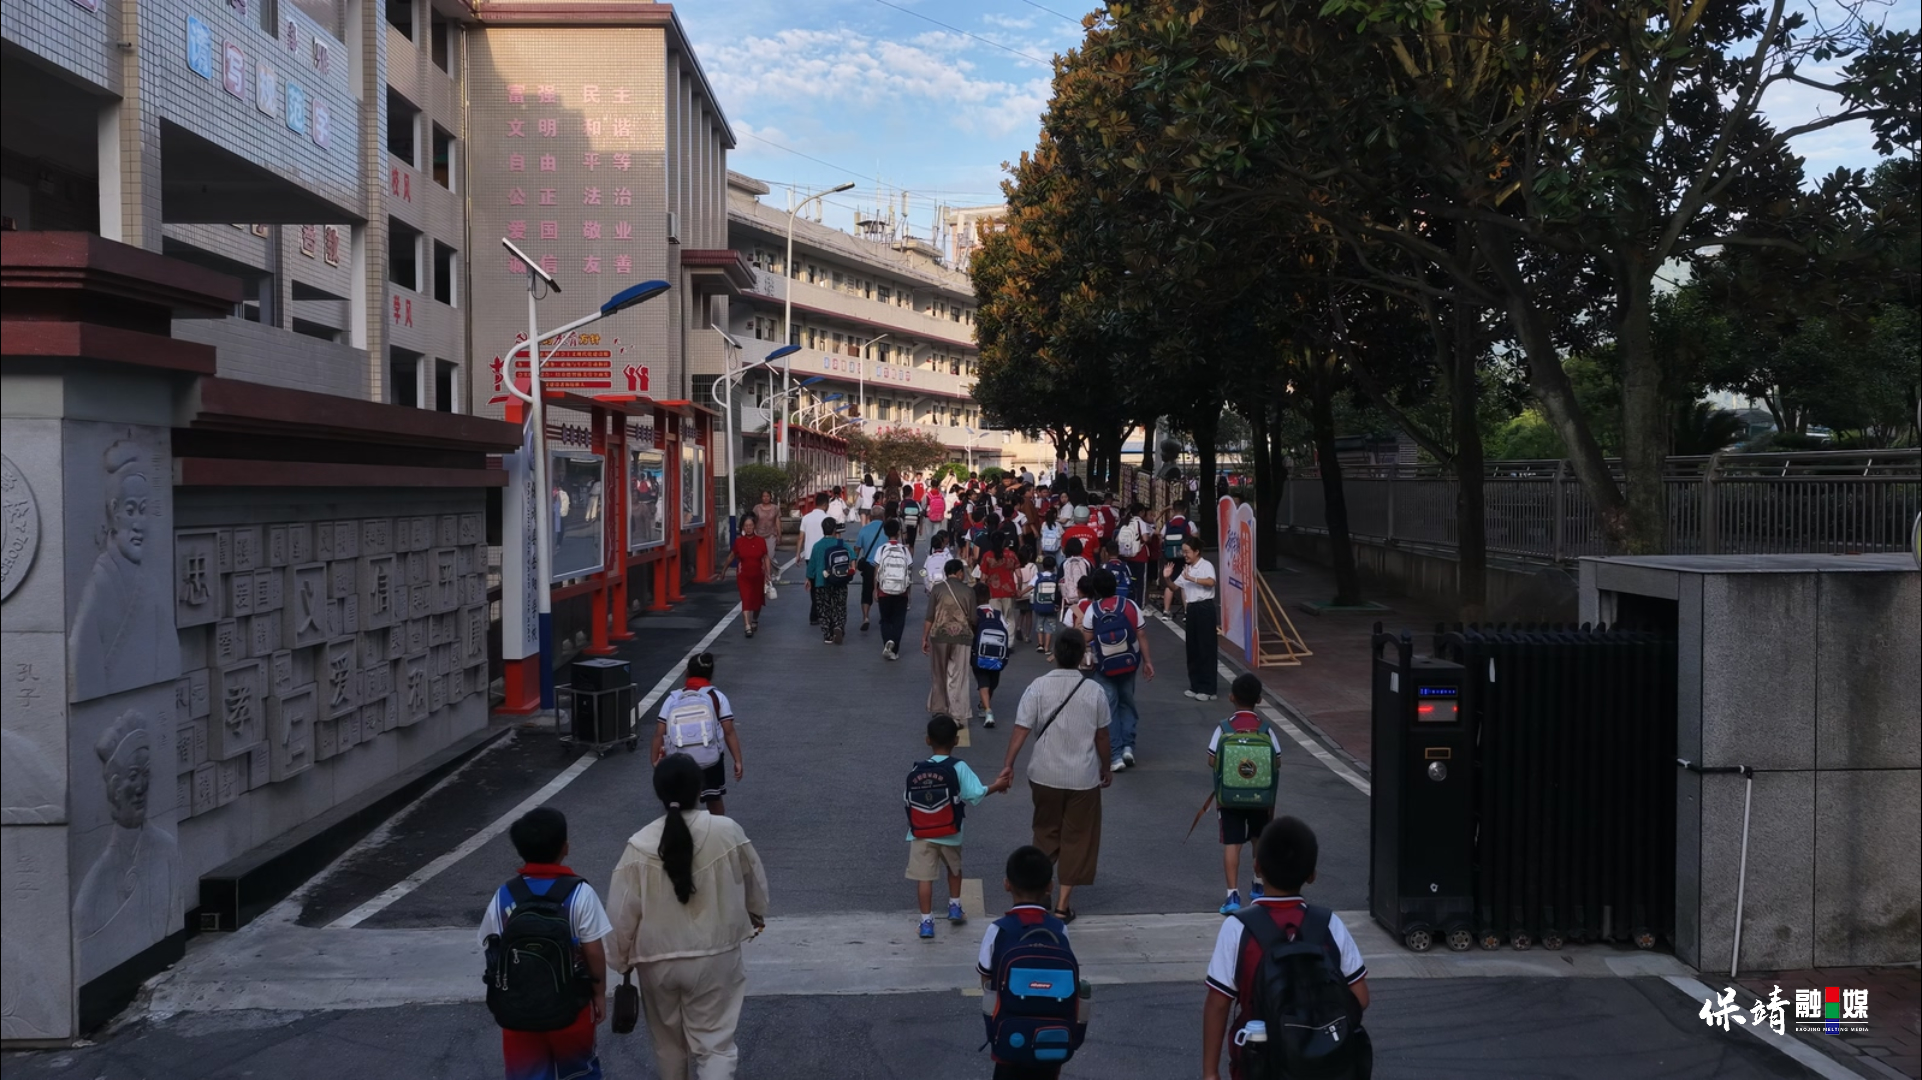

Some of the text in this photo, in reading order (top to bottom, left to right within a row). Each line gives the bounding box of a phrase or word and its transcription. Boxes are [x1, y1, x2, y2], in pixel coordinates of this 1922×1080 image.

[189, 20, 330, 144] 请写规范字
[507, 84, 632, 104] 富强 民主
[507, 117, 632, 138] 文明 和谐
[508, 152, 633, 172] 自由 平等
[391, 166, 411, 204] 校风
[507, 186, 633, 206] 公正 法治
[507, 220, 633, 240] 爱国 敬业
[582, 254, 633, 274] 友善
[393, 294, 413, 329] 学风
[370, 564, 389, 614] 信
[15, 662, 41, 708] 孔子
